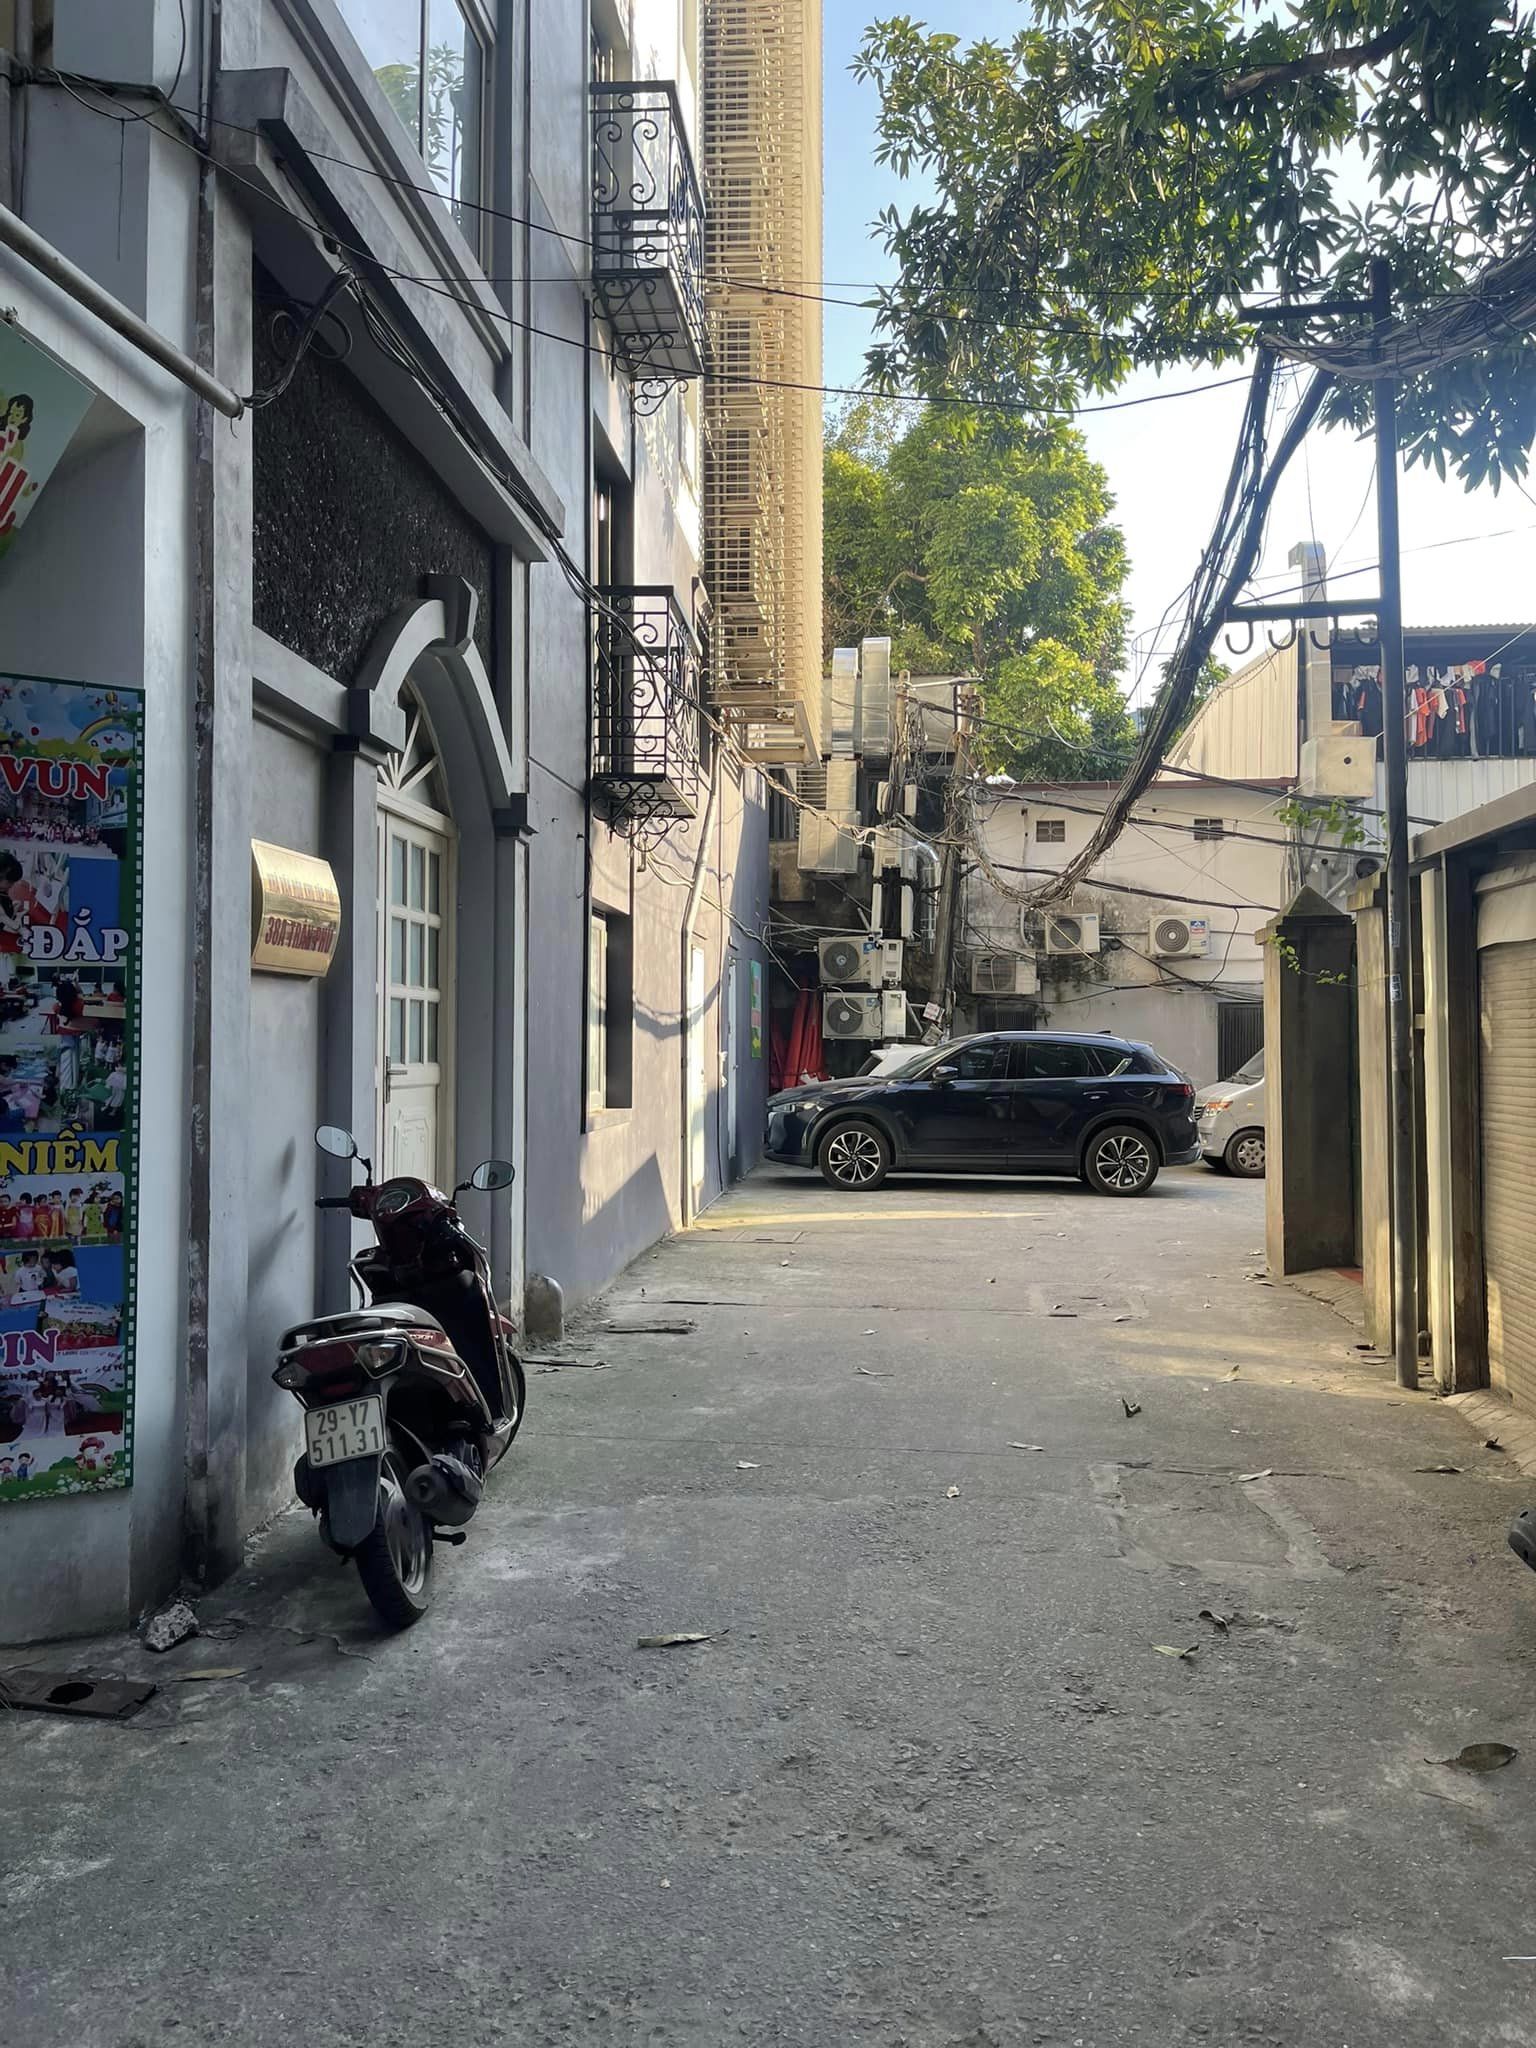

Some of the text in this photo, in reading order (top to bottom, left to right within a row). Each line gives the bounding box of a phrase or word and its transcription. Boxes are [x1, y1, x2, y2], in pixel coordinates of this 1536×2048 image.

[0, 756, 111, 800] VUN
[29, 907, 129, 961] ĐẮP
[0, 1122, 119, 1175] NIỀM
[0, 1328, 60, 1368] IN
[316, 1401, 368, 1435] 29-Y7
[312, 1426, 379, 1463] 511.31
